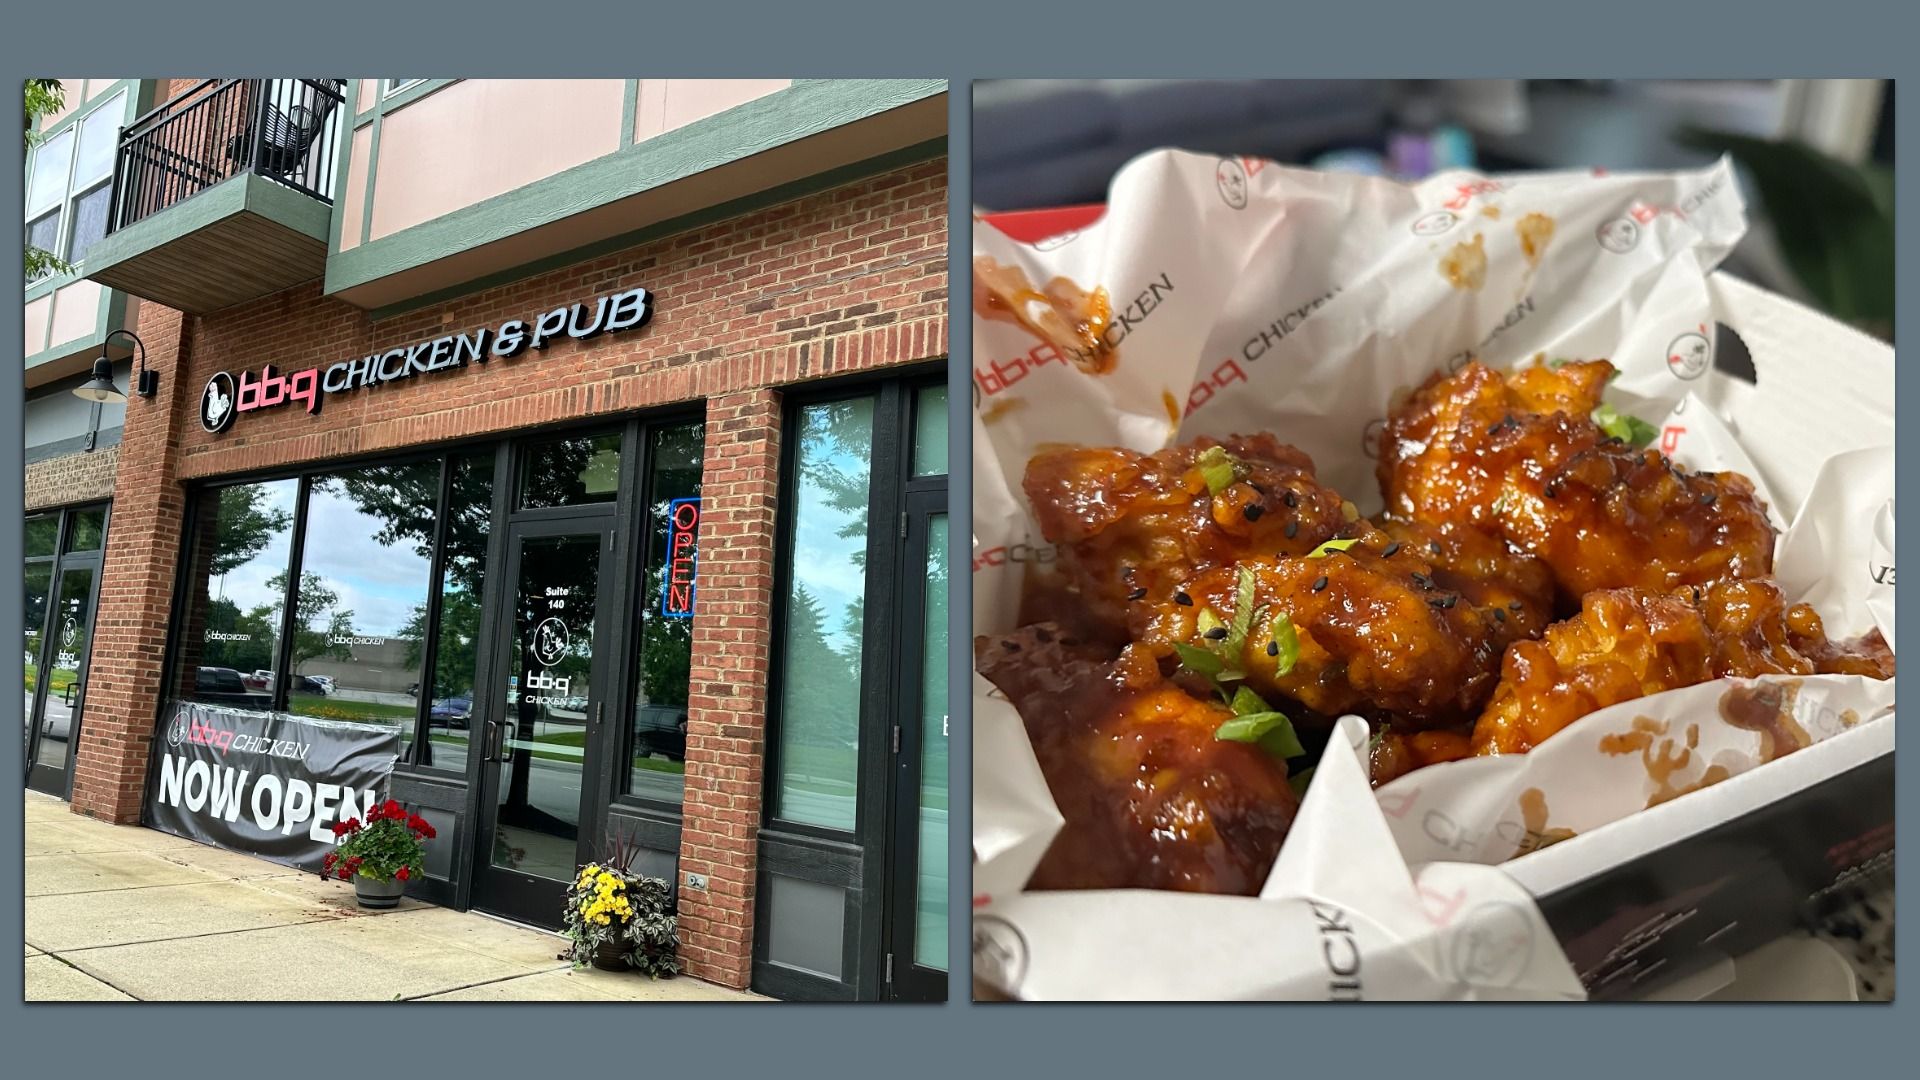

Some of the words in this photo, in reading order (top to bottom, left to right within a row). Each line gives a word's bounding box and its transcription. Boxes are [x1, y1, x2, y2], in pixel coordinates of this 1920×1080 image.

[323, 328, 487, 394] CHICKEN
[492, 320, 525, 356] &
[529, 288, 647, 348] PUB
[669, 503, 698, 611] OPEN
[545, 587, 569, 596] Suite
[548, 600, 565, 609] 140
[226, 633, 252, 641] CHICKEN
[353, 637, 385, 646] CHICKEN
[525, 695, 568, 706] CHICKEN
[232, 734, 311, 760] CHICKEN
[158, 752, 249, 823] NOW
[251, 773, 376, 847] OPEN
